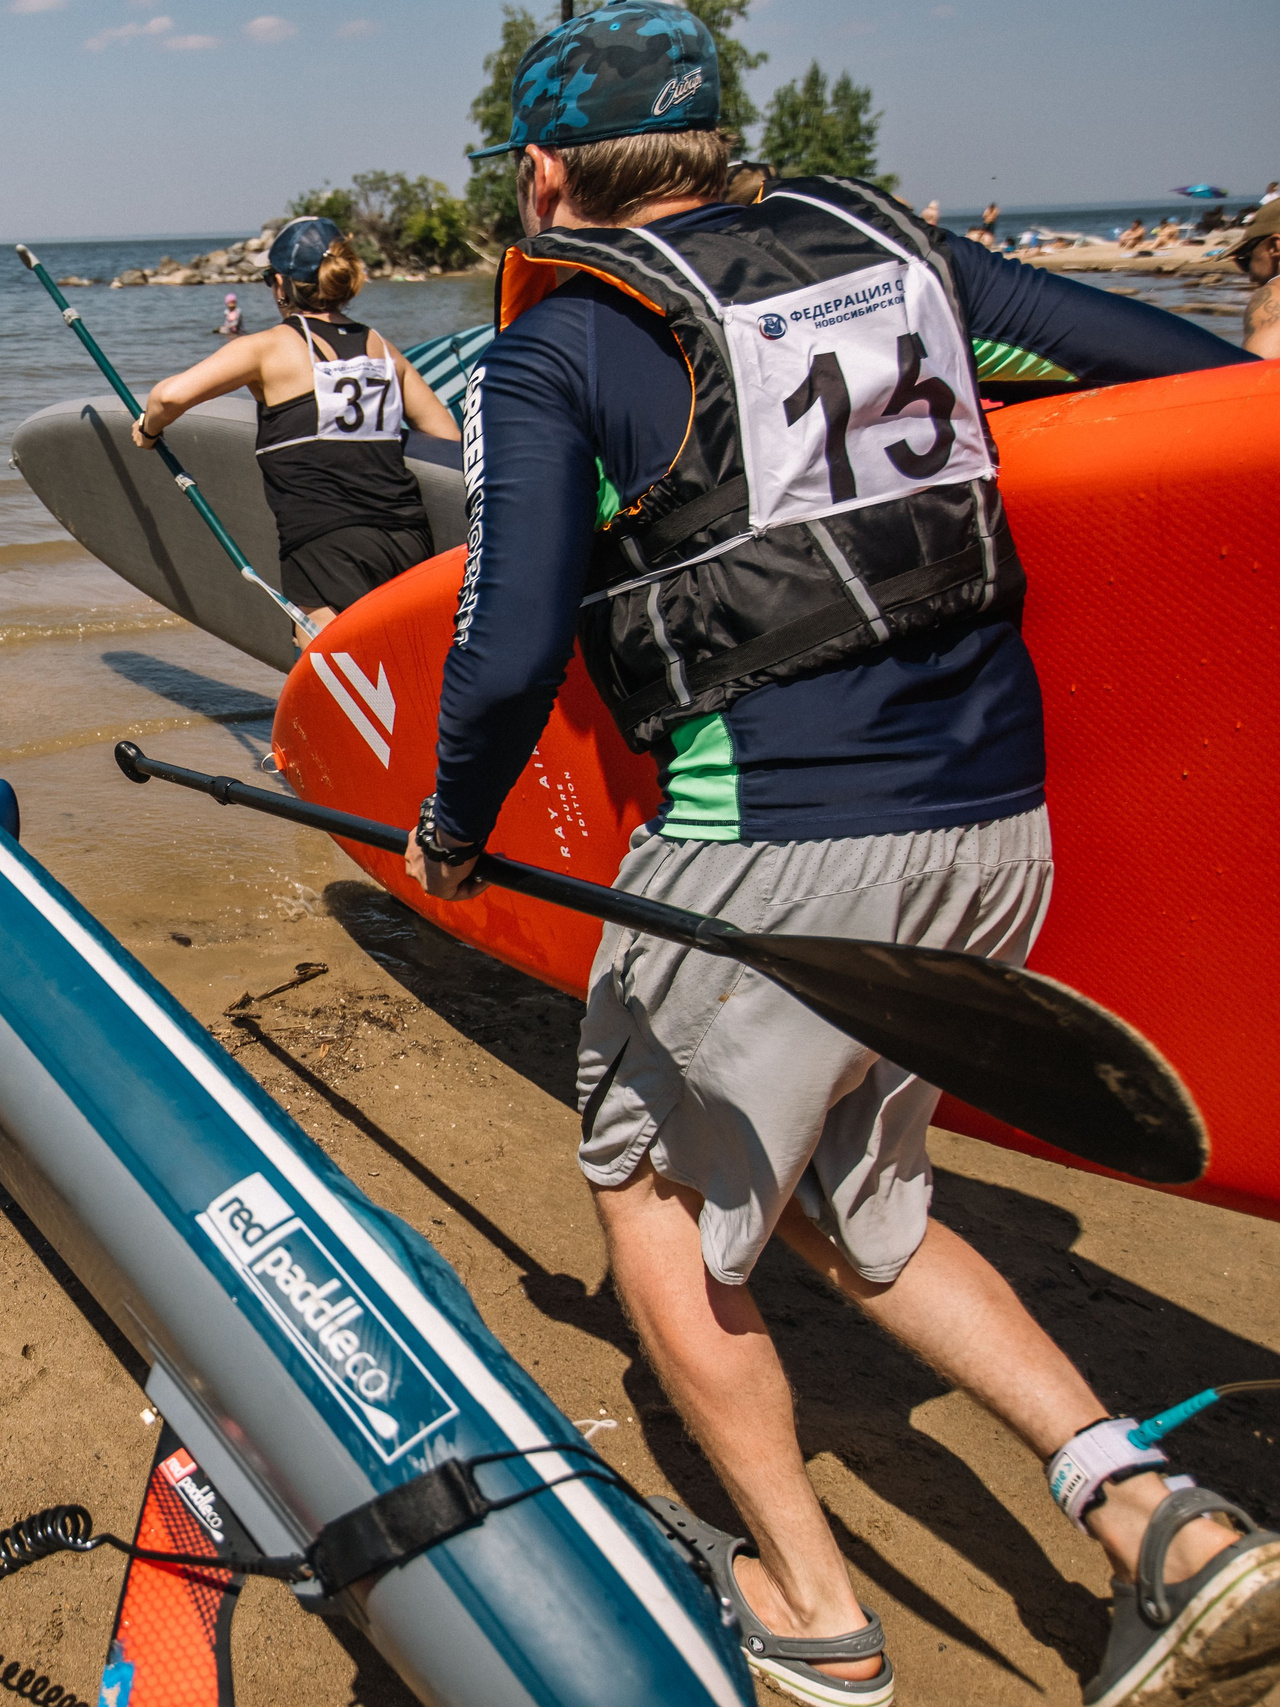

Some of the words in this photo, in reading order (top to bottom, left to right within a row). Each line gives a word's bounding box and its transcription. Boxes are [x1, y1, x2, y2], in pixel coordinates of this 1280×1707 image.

[789, 281, 892, 323] ФЕДЕРАЦИЯ
[333, 377, 391, 433] 37
[783, 332, 956, 504] 15
[563, 771, 589, 837] EDITION
[547, 807, 571, 858] RAY
[219, 1196, 282, 1249] red
